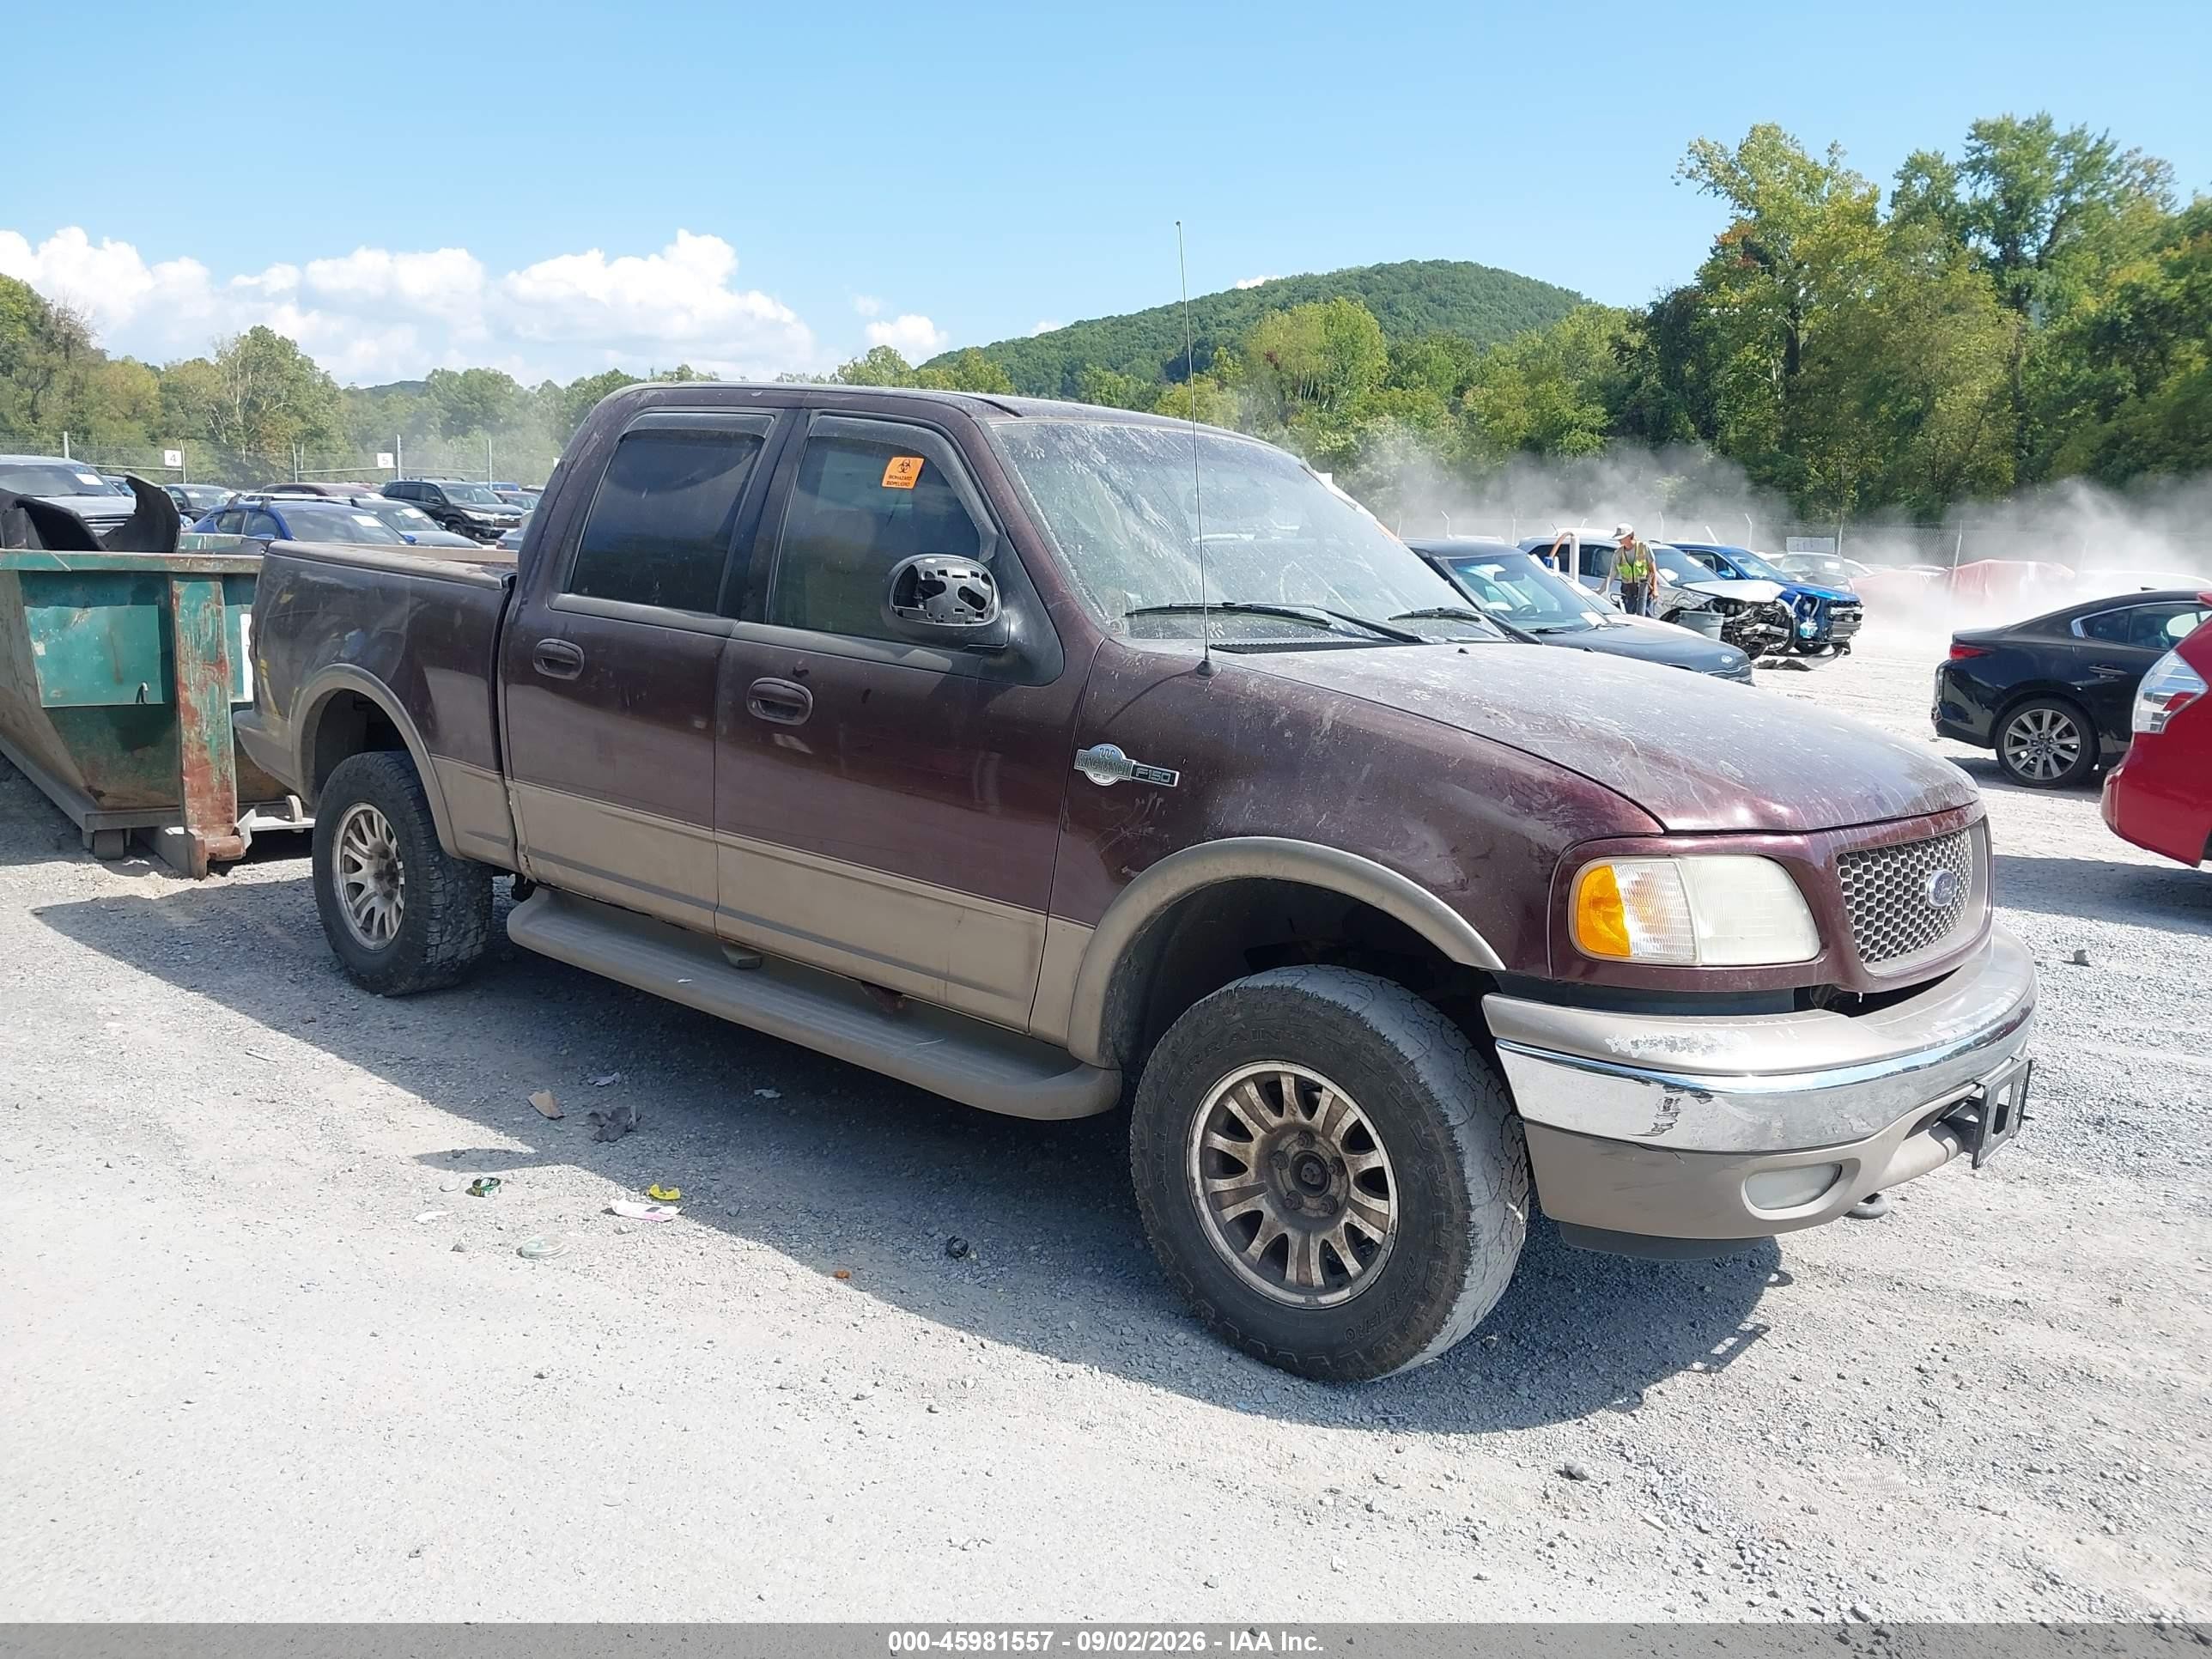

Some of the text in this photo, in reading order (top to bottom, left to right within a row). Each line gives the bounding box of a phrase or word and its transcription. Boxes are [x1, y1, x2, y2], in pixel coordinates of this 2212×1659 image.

[382, 456, 389, 465] 5
[1078, 753, 1130, 775] KING RANCH
